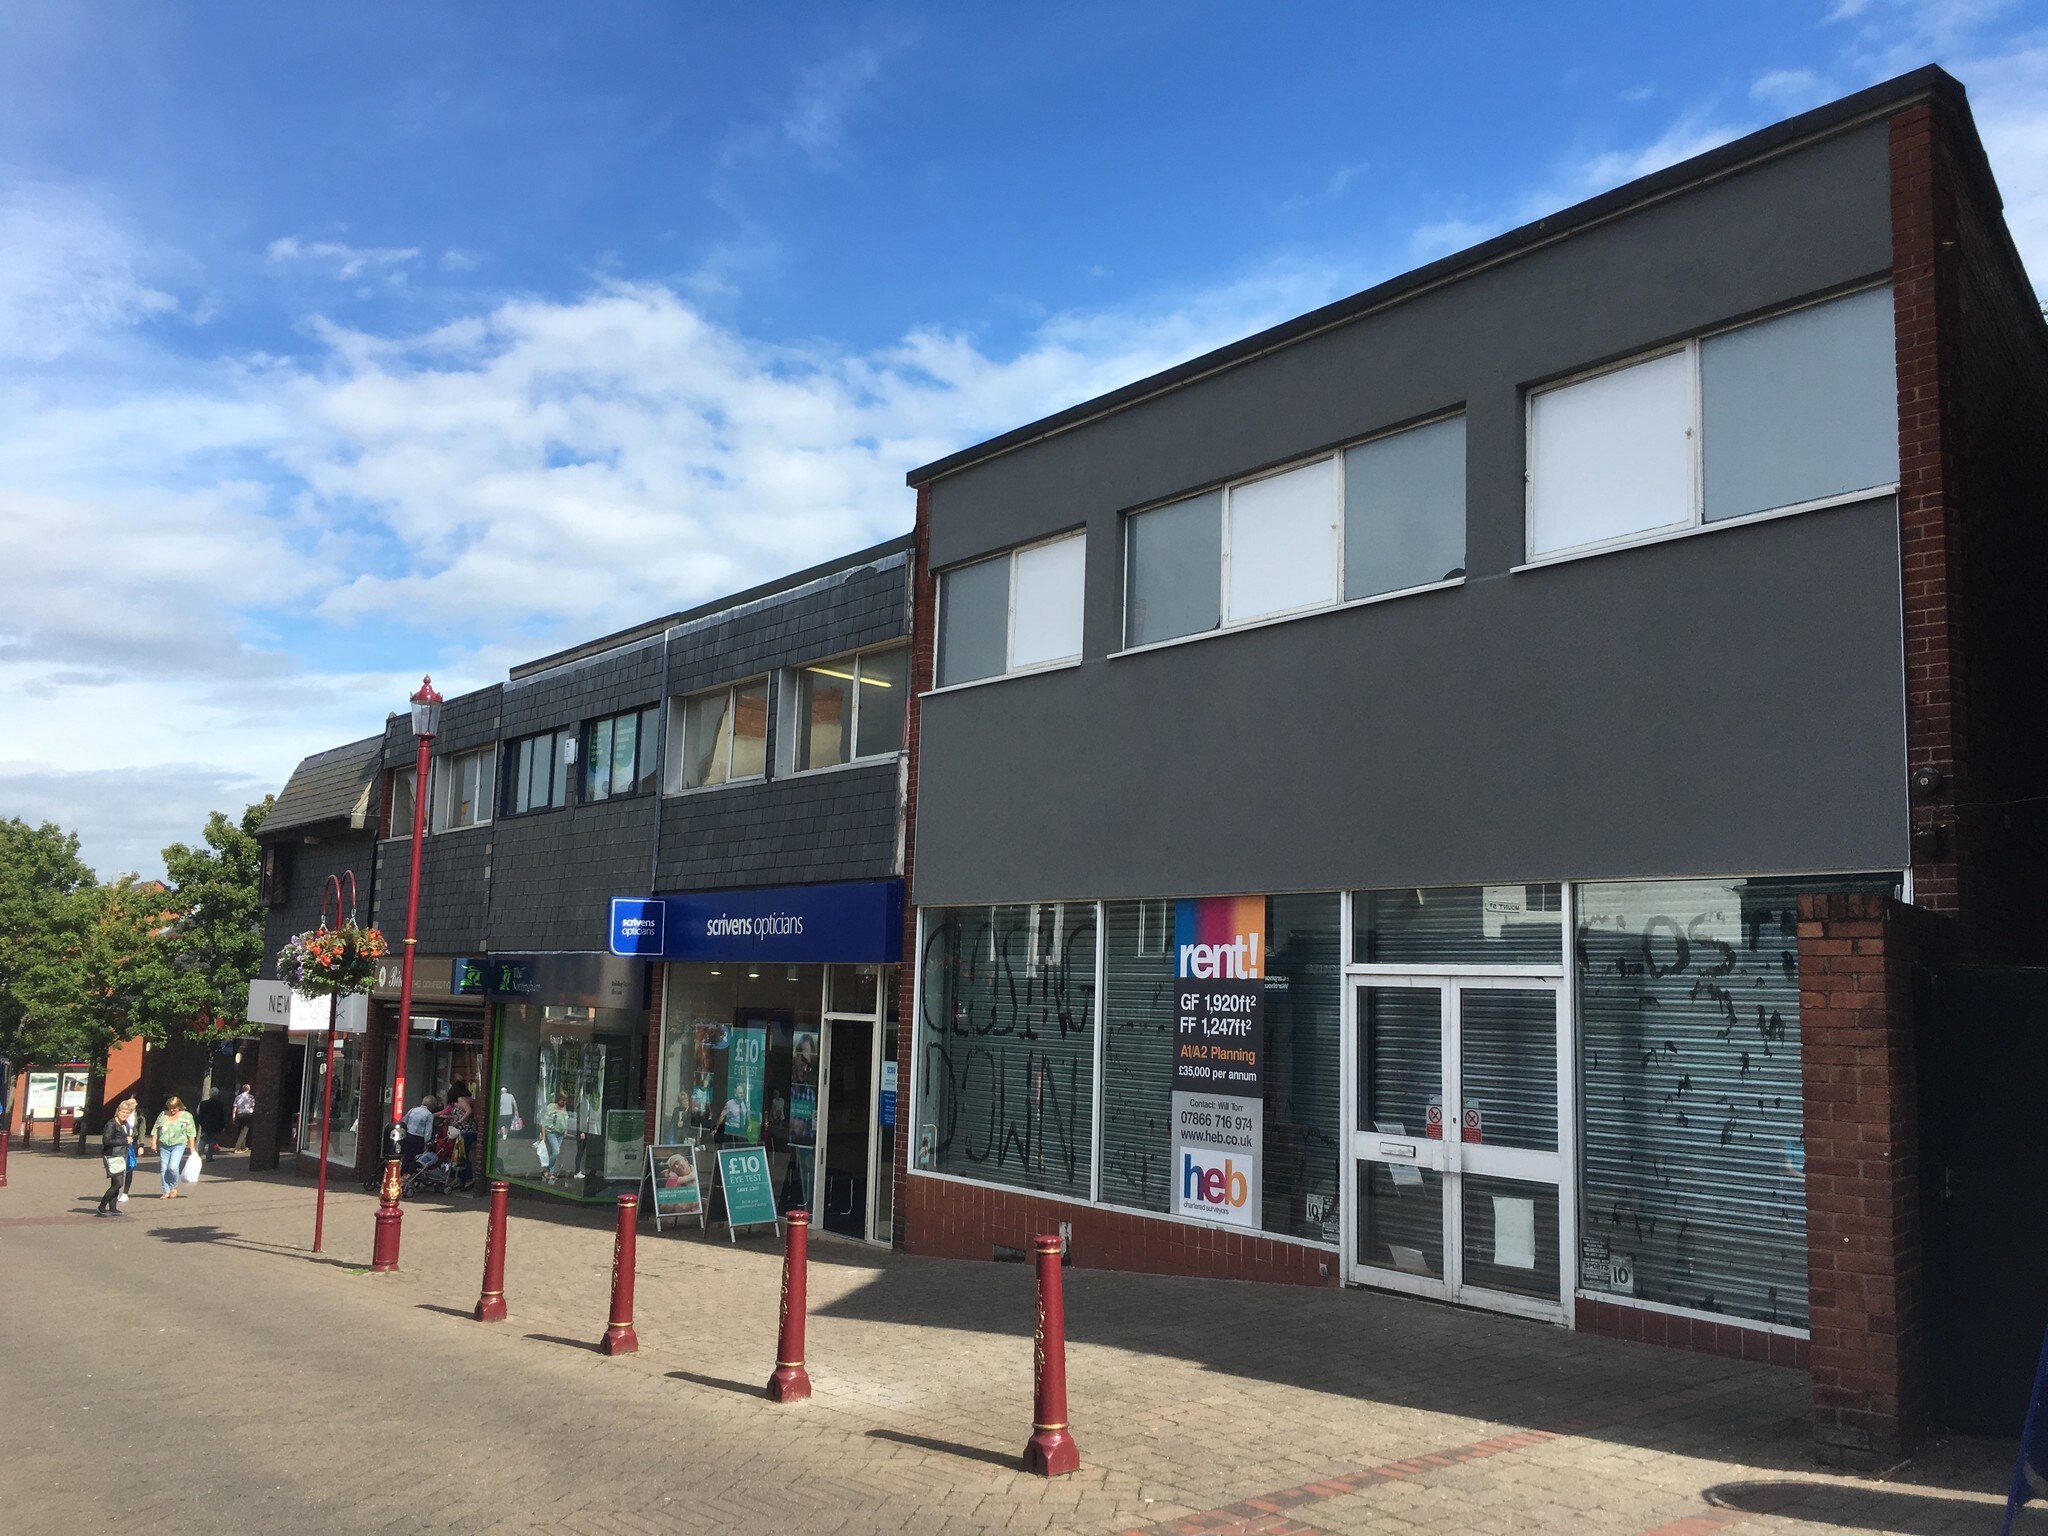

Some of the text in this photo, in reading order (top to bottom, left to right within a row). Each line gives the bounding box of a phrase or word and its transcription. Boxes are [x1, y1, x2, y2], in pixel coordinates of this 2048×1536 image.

[622, 917, 655, 927] scrivens
[706, 911, 803, 940] scrivens opticians
[622, 926, 655, 937] opticians
[1180, 932, 1259, 979] rent!
[513, 967, 522, 979] The
[1180, 993, 1200, 1010] GF
[1180, 1017, 1197, 1034] FF
[734, 1038, 759, 1063] £10
[1180, 1044, 1256, 1065] A1/A2 Planning
[1179, 1065, 1257, 1082] £35,000 per annum
[1189, 1099, 1243, 1112] Contact: Will Torr
[1180, 1111, 1253, 1131] 07866 716 974
[1180, 1129, 1253, 1147] www.heb.co.uk
[728, 1155, 760, 1175] £10
[730, 1173, 761, 1184] EYE TEST
[1184, 1153, 1248, 1208] heb
[1183, 1201, 1229, 1215] chartered surveyors
[1584, 1262, 1610, 1271] SPORTS
[1612, 1266, 1629, 1284] 10
